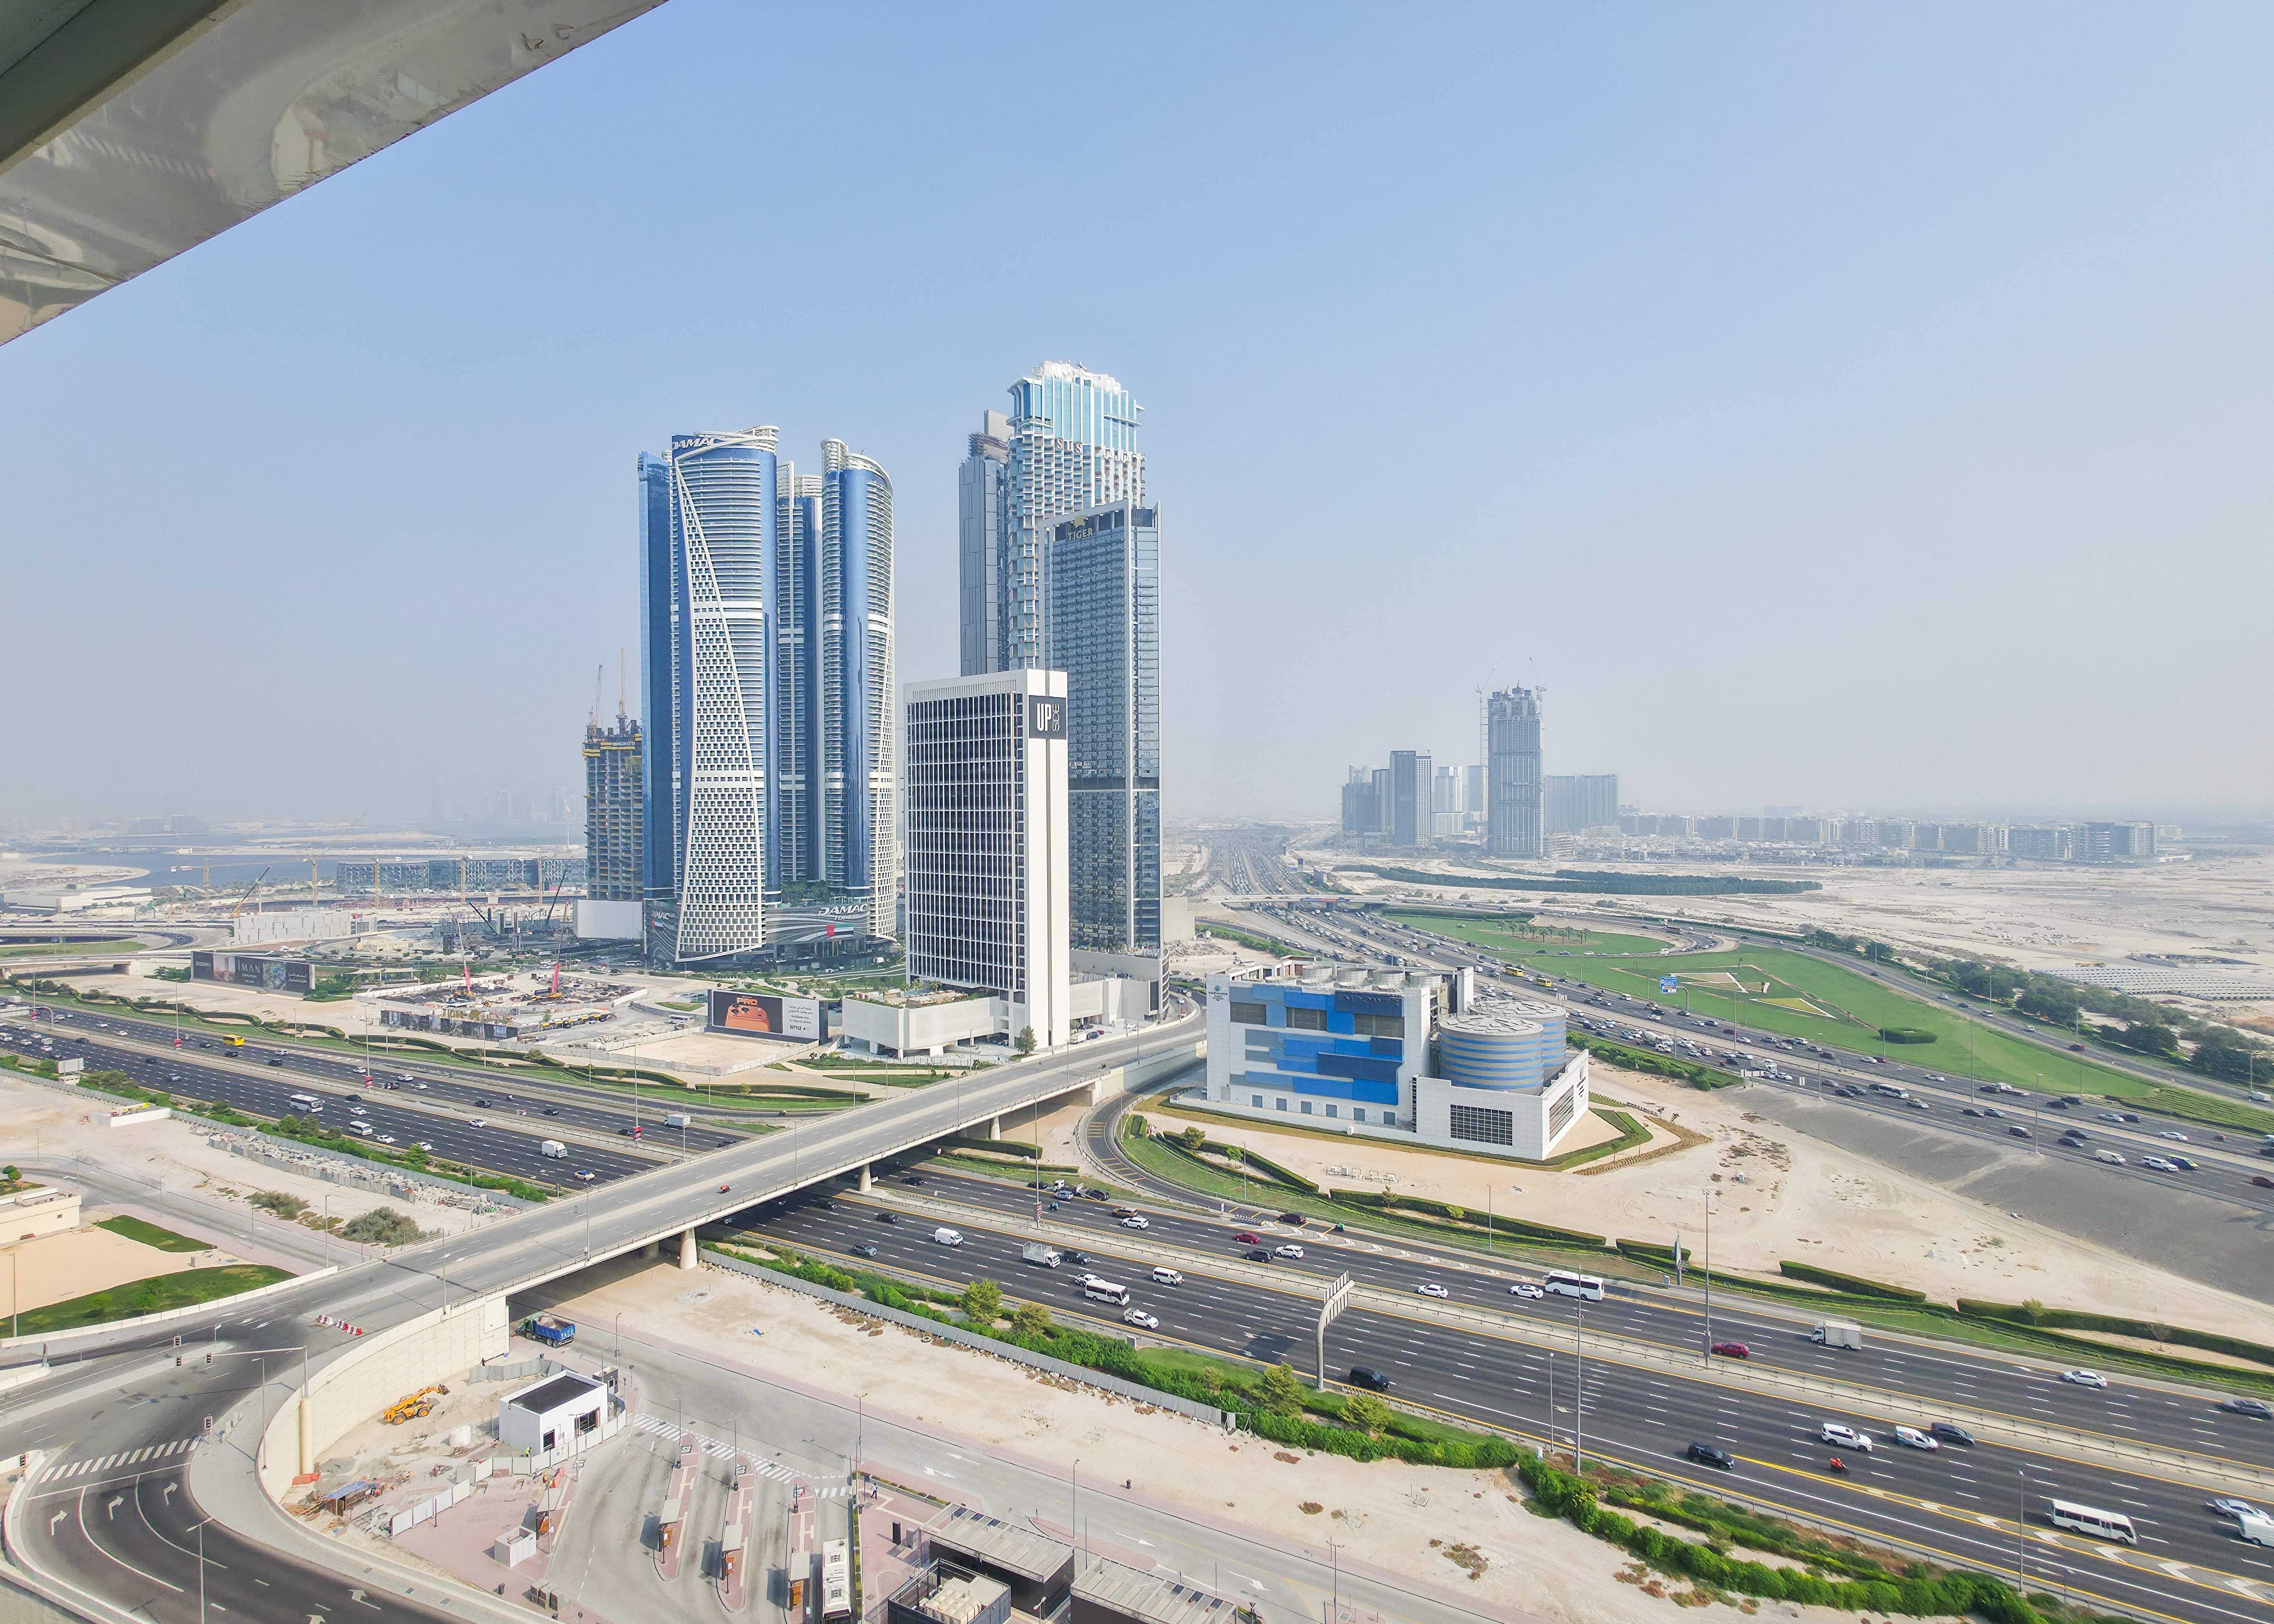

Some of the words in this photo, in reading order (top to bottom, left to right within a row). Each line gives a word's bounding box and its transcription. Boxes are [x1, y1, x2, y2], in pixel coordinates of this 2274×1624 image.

[1068, 528, 1093, 541] TIGER
[1037, 702, 1052, 731] UP
[818, 904, 868, 915] DAMAC
[238, 959, 261, 973] IMAN
[737, 997, 758, 1005] PRO
